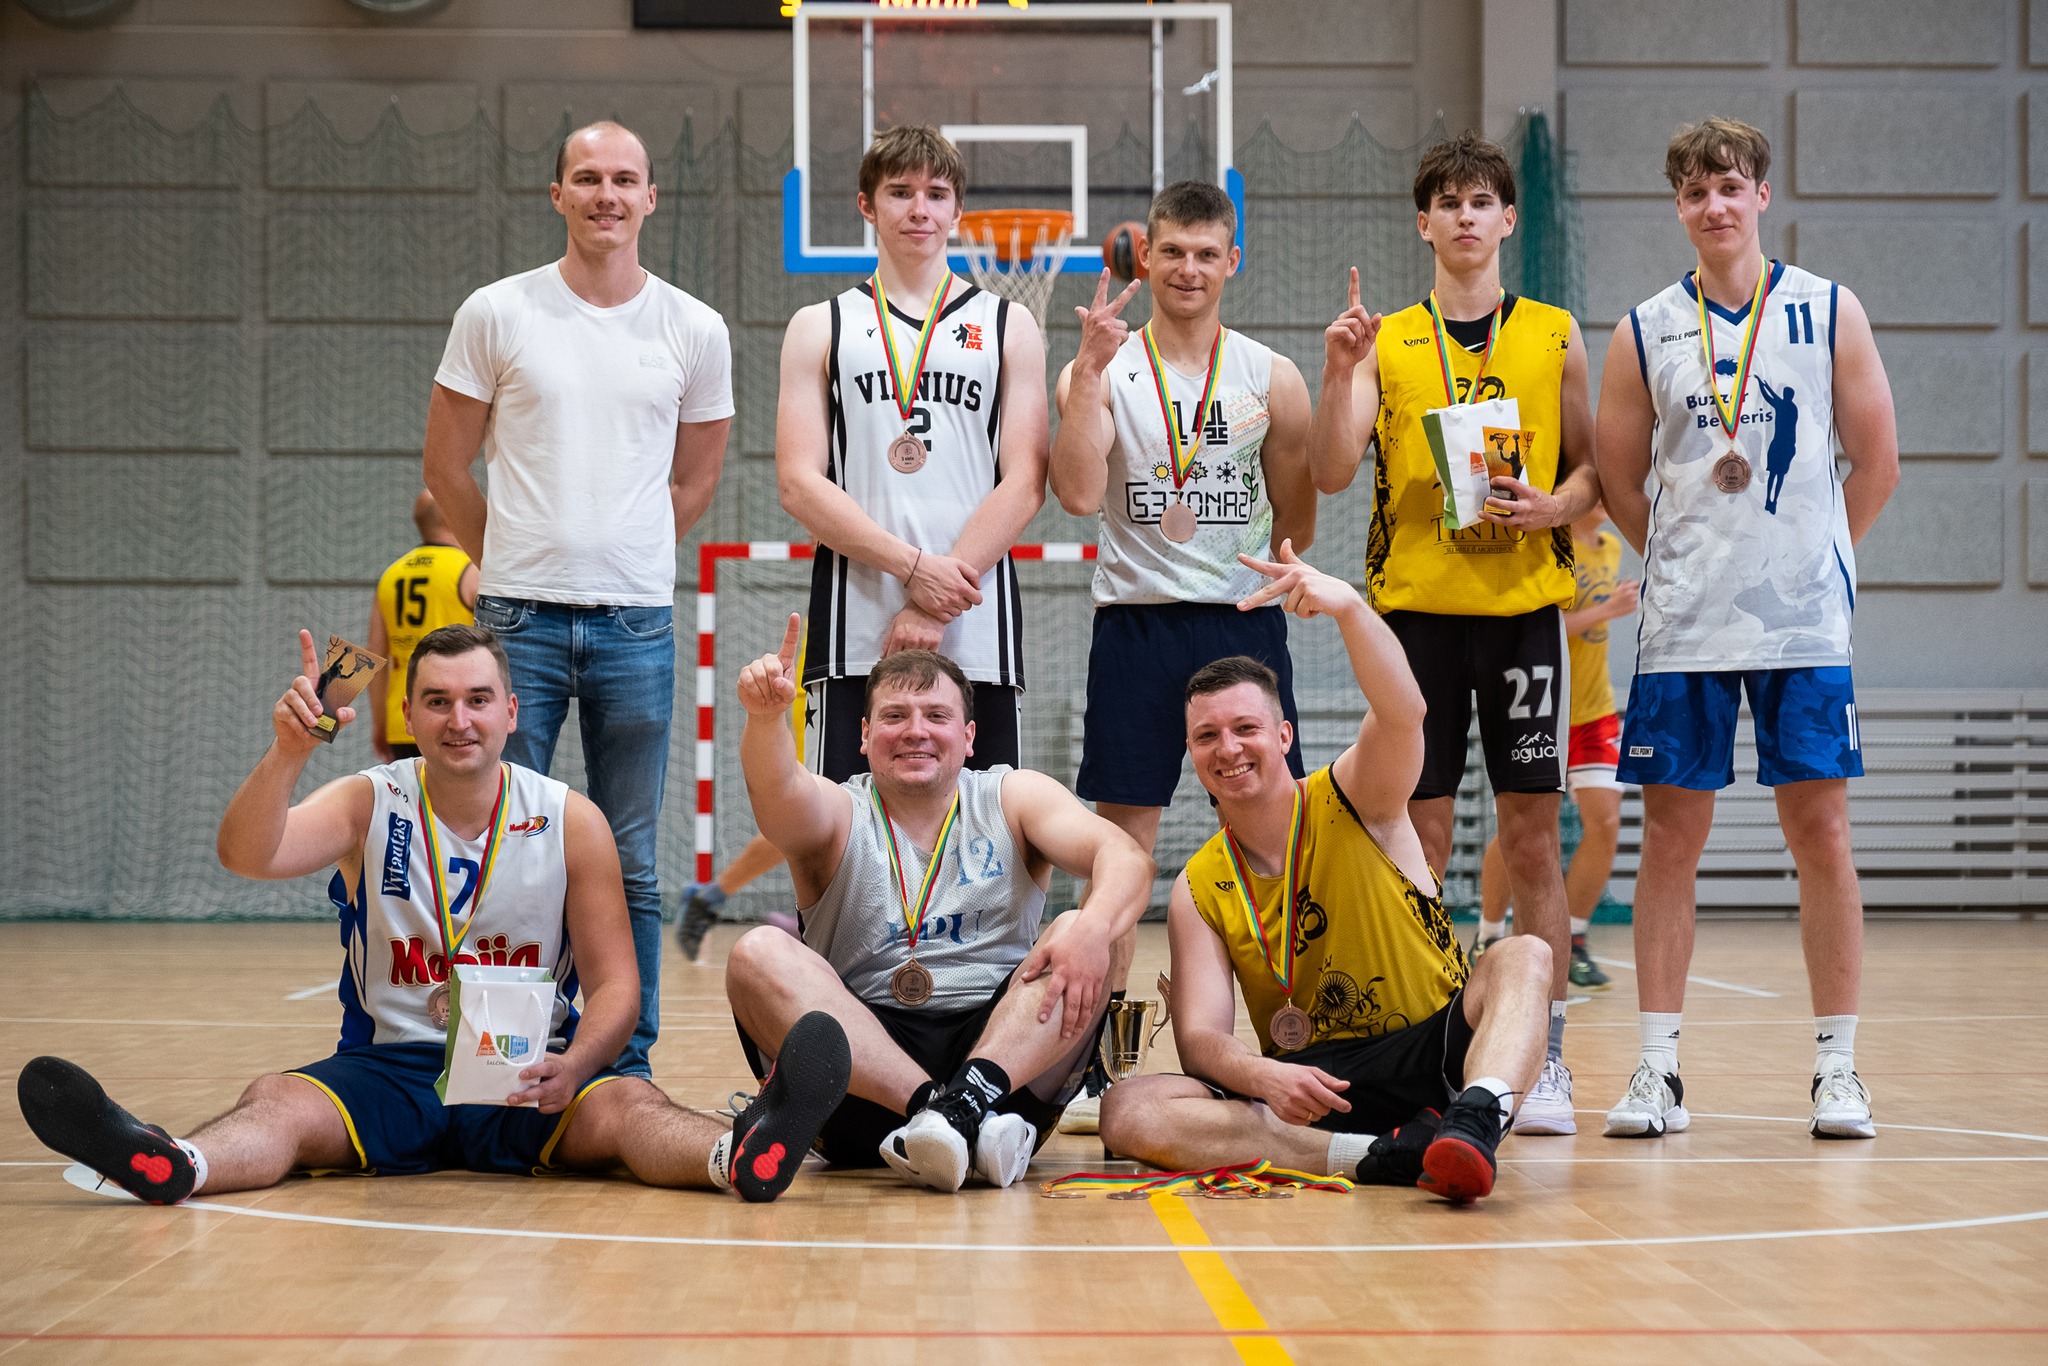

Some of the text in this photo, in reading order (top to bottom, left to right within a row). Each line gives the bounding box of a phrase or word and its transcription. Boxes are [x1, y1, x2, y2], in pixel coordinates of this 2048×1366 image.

[1660, 328, 1702, 344] HUSTLE POINT
[1784, 302, 1814, 344] 11
[854, 370, 982, 412] VINIUS
[1685, 392, 1749, 410] Buzzr
[906, 407, 932, 452] 2
[395, 577, 428, 628] 15
[1503, 665, 1554, 720] 27
[384, 818, 407, 893] Vytautas
[951, 836, 1004, 887] 12
[448, 856, 480, 915] 7
